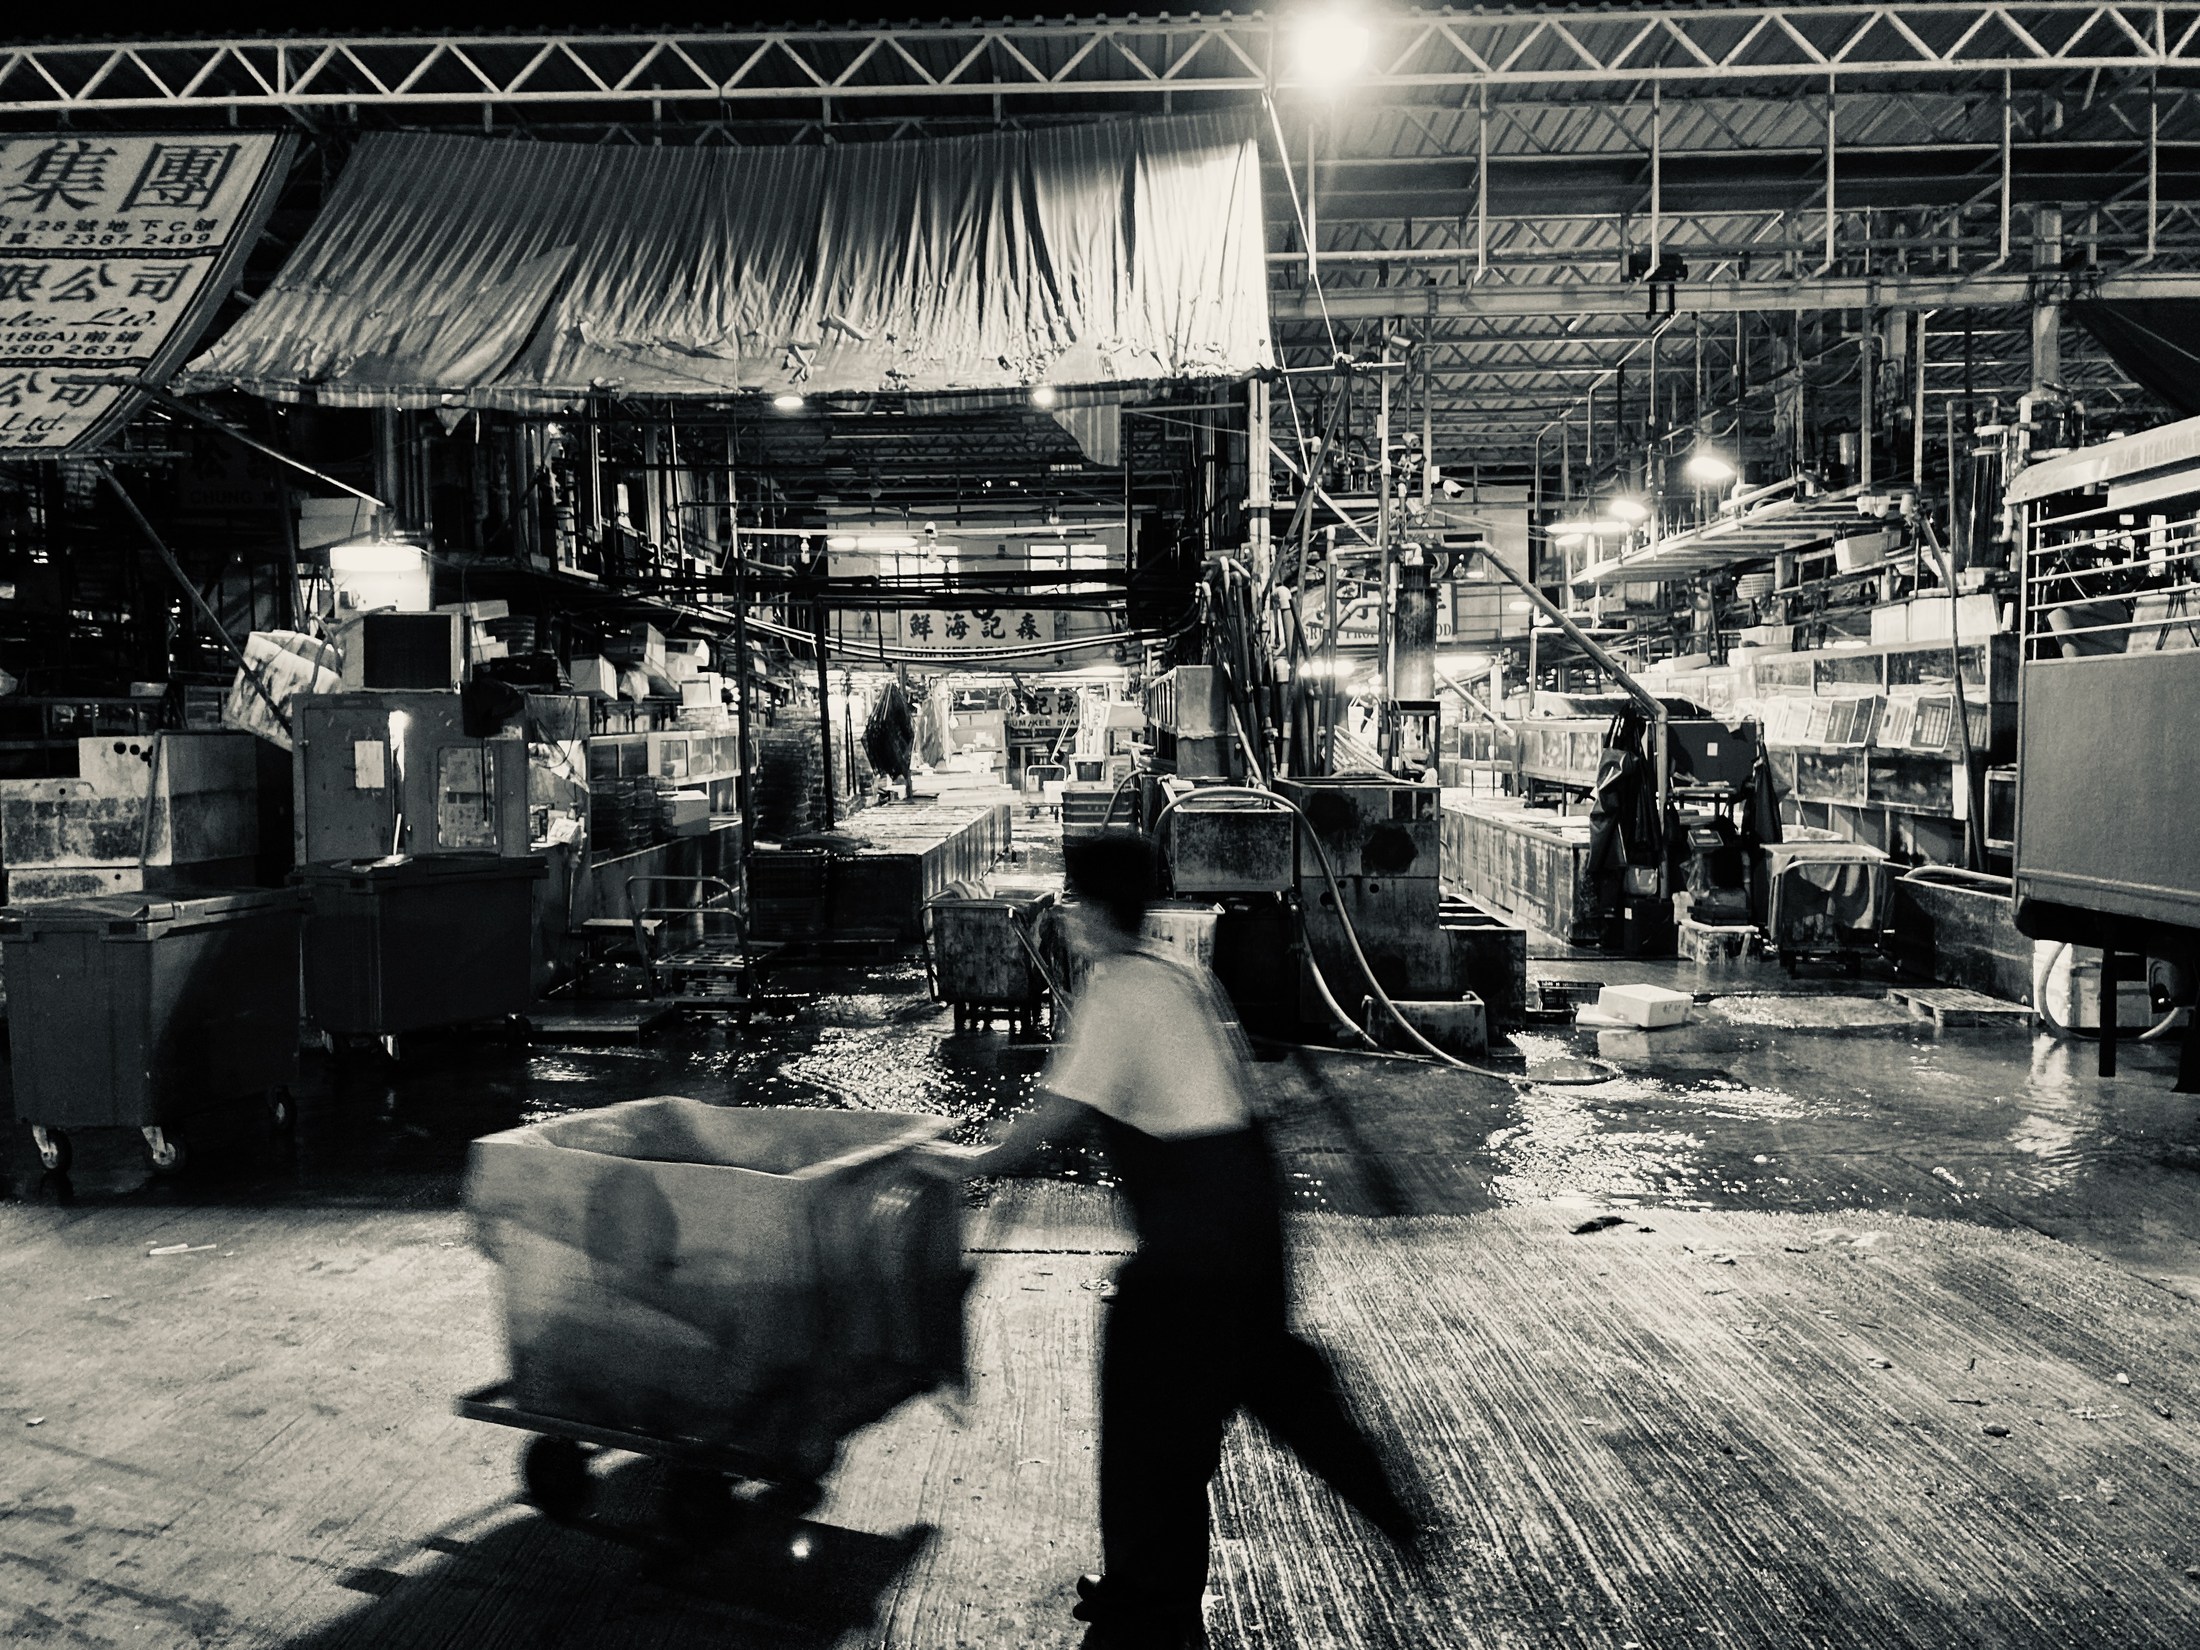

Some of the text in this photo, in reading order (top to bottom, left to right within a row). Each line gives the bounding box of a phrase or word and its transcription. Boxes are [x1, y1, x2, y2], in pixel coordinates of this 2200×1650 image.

[3, 141, 242, 213] 集團
[141, 232, 211, 245] 2499
[0, 345, 54, 355] 580
